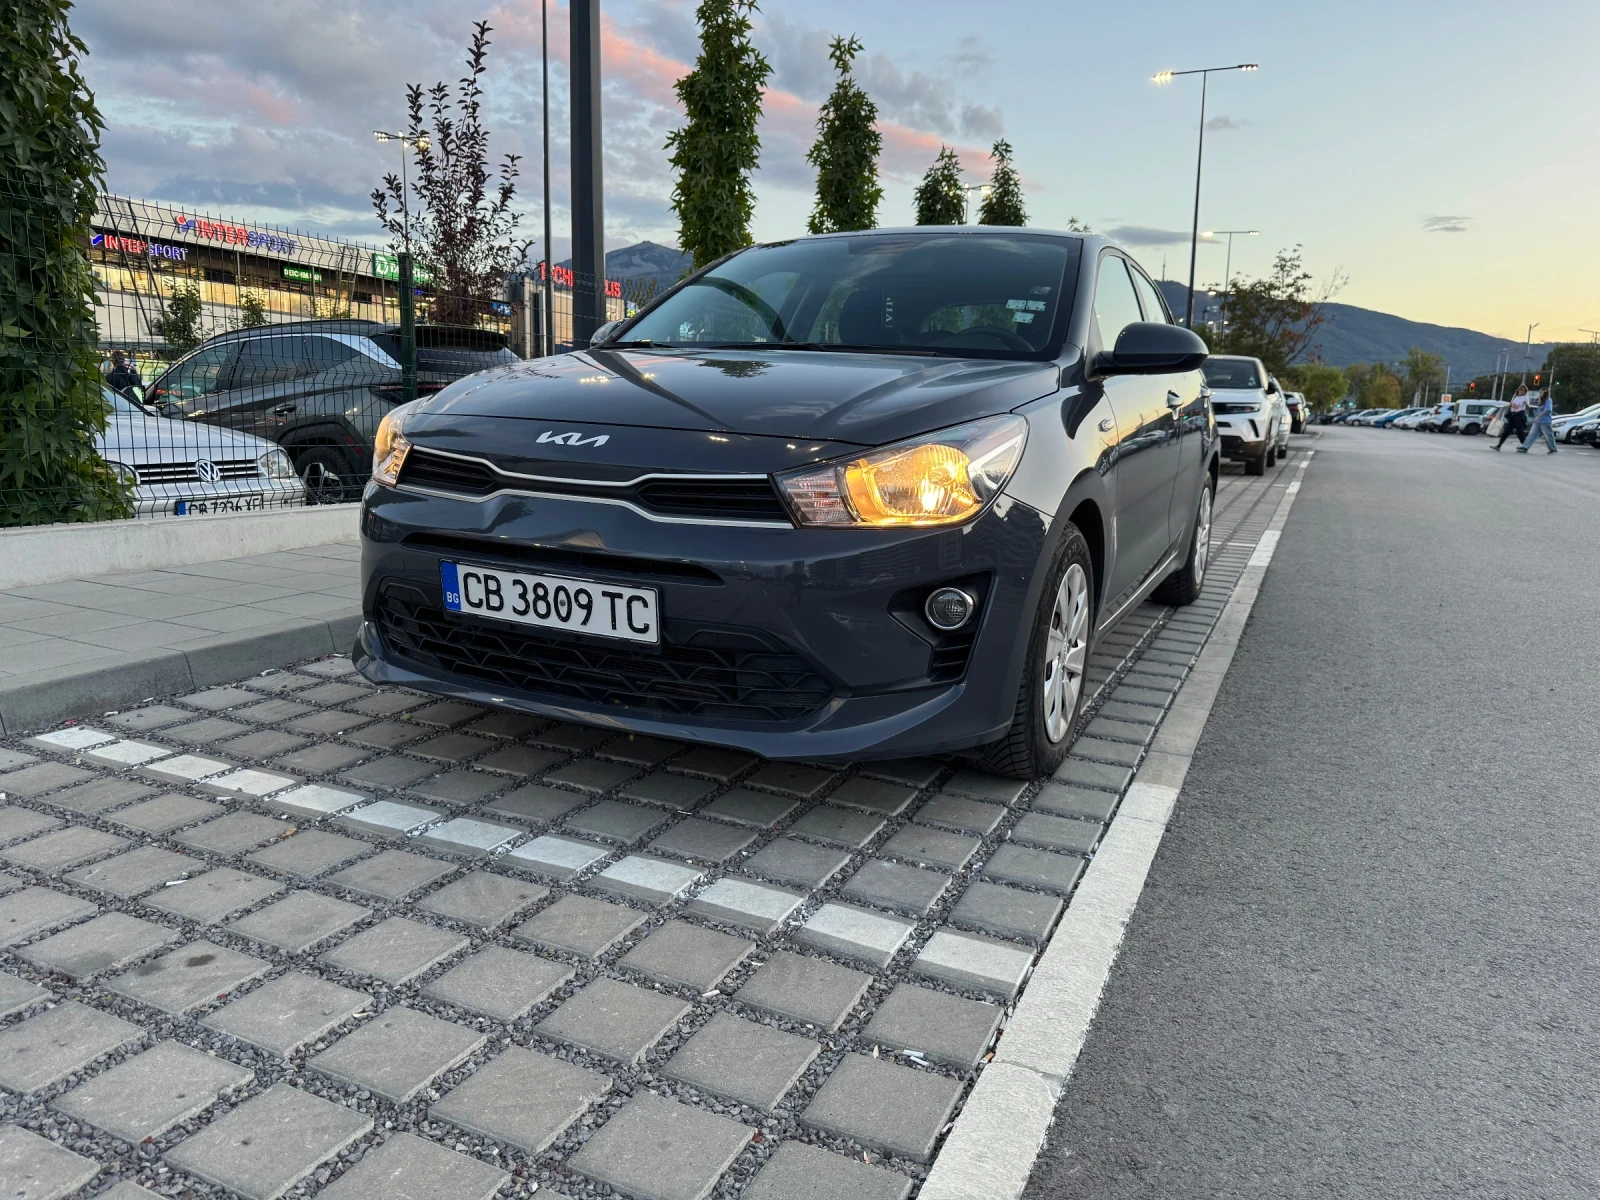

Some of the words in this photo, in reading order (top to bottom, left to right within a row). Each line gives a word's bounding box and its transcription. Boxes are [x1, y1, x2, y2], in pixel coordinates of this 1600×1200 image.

[104, 234, 188, 261] INTERSPORT
[196, 218, 298, 255] INTERSPORT
[535, 430, 611, 448] KIA
[446, 591, 460, 604] BG
[462, 571, 505, 612] CB
[511, 578, 594, 627] 3809
[601, 590, 650, 634] TC
